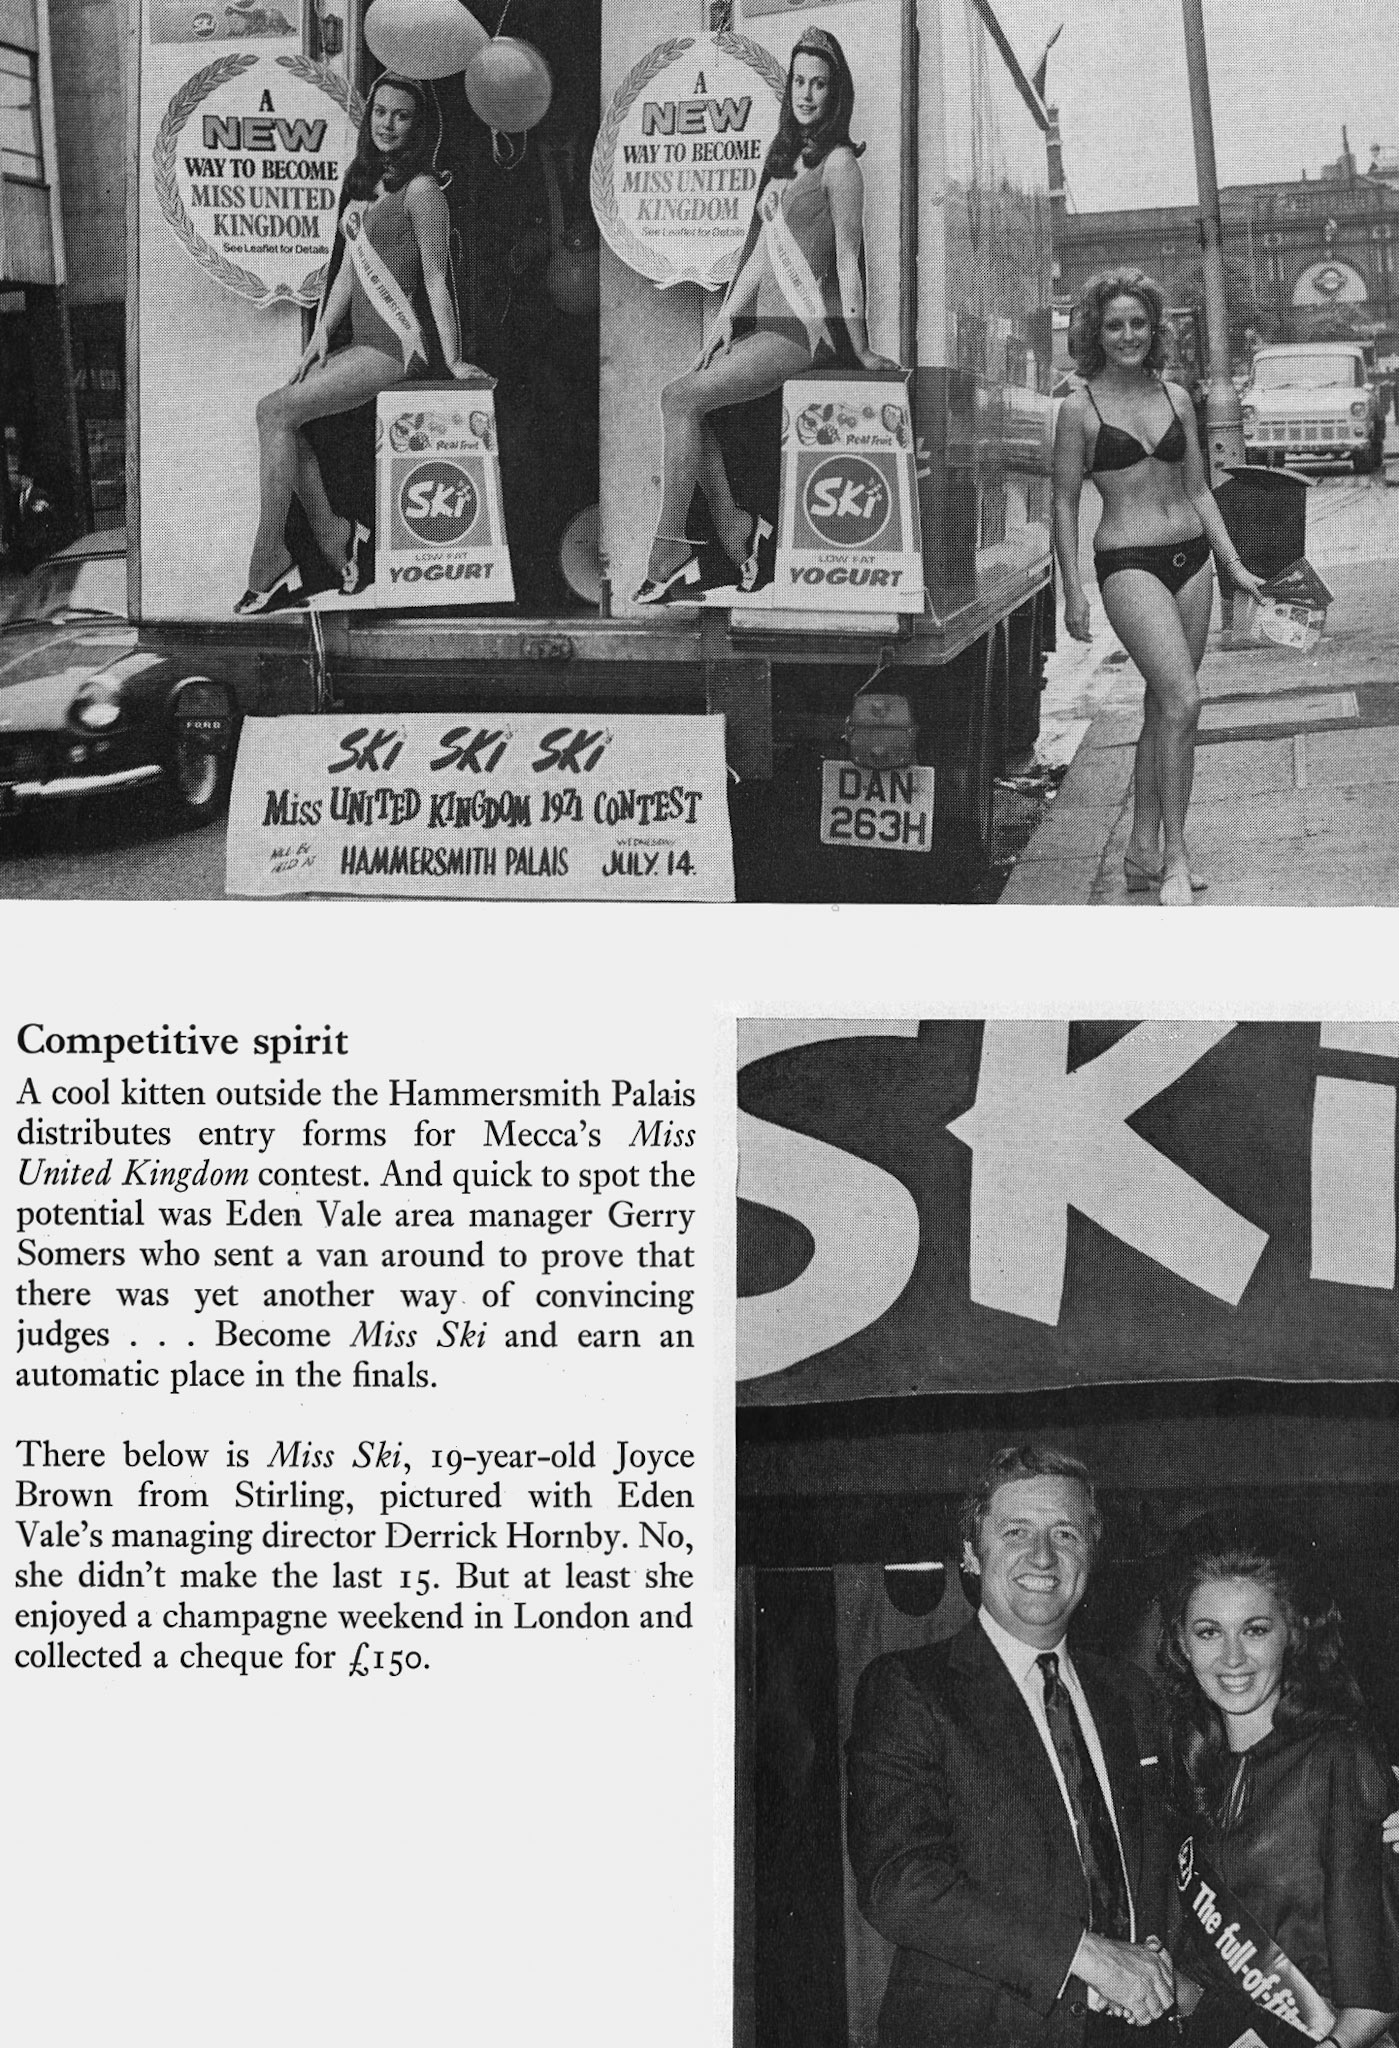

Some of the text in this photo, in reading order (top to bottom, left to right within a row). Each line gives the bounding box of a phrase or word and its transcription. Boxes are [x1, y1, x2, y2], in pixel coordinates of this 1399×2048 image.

[259, 89, 275, 112] A
[694, 71, 708, 94] A
[202, 115, 328, 153] NEW
[641, 95, 753, 136] NEW
[184, 157, 339, 181] WAY TO BECOME
[623, 139, 762, 164] WAY TO BECOME
[191, 184, 336, 211] MISS UNITED
[622, 167, 757, 193] MISS UNITED
[213, 213, 321, 239] KINGDOM
[636, 197, 740, 221] KINGDOM
[223, 242, 329, 255] See Leaflet for Details
[388, 562, 495, 584] YOGURT
[789, 566, 904, 588] YOGURT
[818, 554, 876, 564] LOW FAT
[838, 767, 914, 804] DAN
[329, 785, 422, 827] UNITED
[427, 789, 532, 829] KINGDOM
[540, 787, 584, 824] 1971
[593, 785, 703, 826] CONTEST
[829, 805, 927, 845] 263H
[340, 845, 569, 877] HAMMERSMITH PALAIS
[17, 1023, 349, 1064] Competitive spirit
[15, 1077, 696, 1107] A cool kitten outside the Hammersmith Palais
[17, 1117, 696, 1154] distributes entry forms for Mecca's Miss
[19, 1157, 696, 1195] United Kingdom contest. And quick to spot the
[16, 1198, 696, 1235] potential was Eden Vale area manager Gerry
[17, 1238, 695, 1276] Somers who sent a van around to prove that
[15, 1278, 695, 1316] there was yet another way of convincing
[16, 1318, 695, 1354] judges Become Miss Ski and earn an
[15, 1439, 695, 1476] There below is Miss Ski, 19-year-old Joyce
[15, 1479, 695, 1516] Brown from Stirling, pictured with Eden
[15, 1519, 694, 1556] Vale's managing director Derrick Hornby. No,
[15, 1559, 694, 1597] she didn't make the last 15. But at least she
[14, 1640, 430, 1677] collected a cheque for £150.
[1192, 1880, 1223, 1935] The
